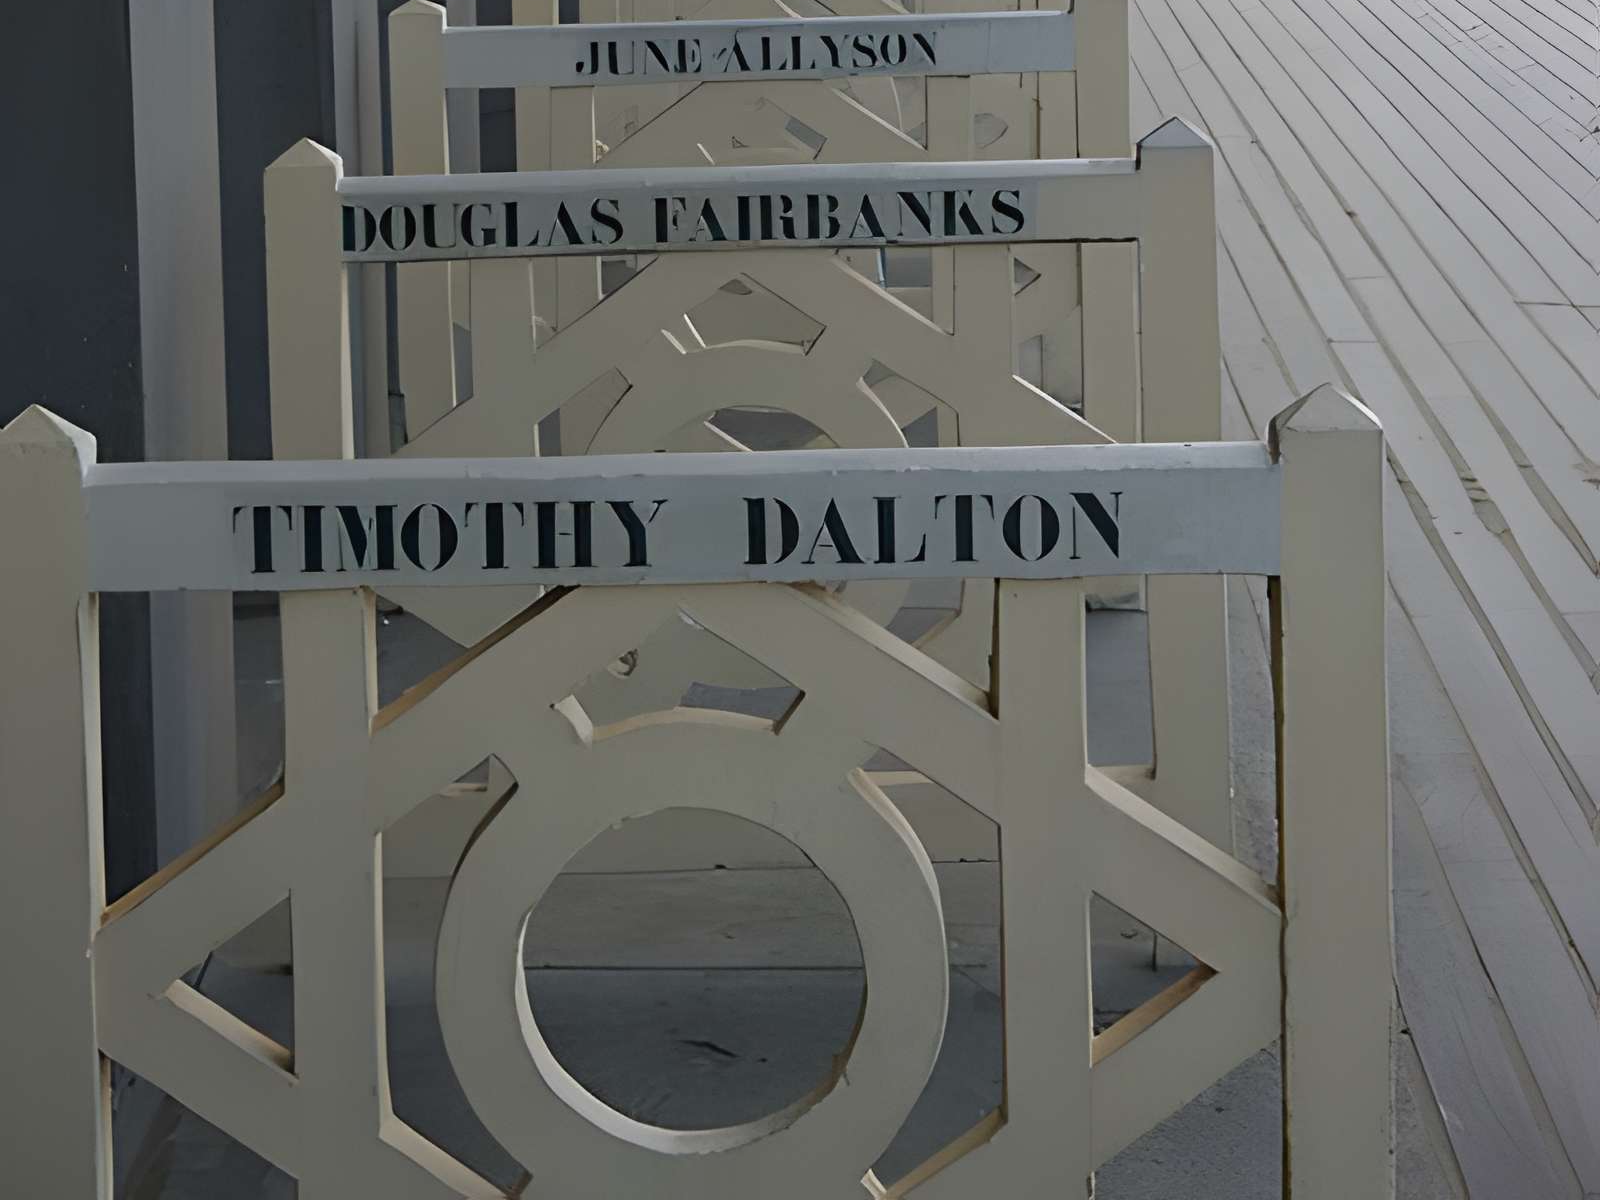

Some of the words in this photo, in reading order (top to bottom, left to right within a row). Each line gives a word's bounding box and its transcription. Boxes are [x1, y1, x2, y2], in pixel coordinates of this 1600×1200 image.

[575, 38, 701, 76] JUNE
[716, 31, 938, 72] ALLYSON
[342, 197, 624, 253] DOUGLAS
[655, 189, 1025, 244] FAIRBANKS
[231, 498, 669, 574] TIMOTHY
[741, 490, 1122, 566] DALTON
